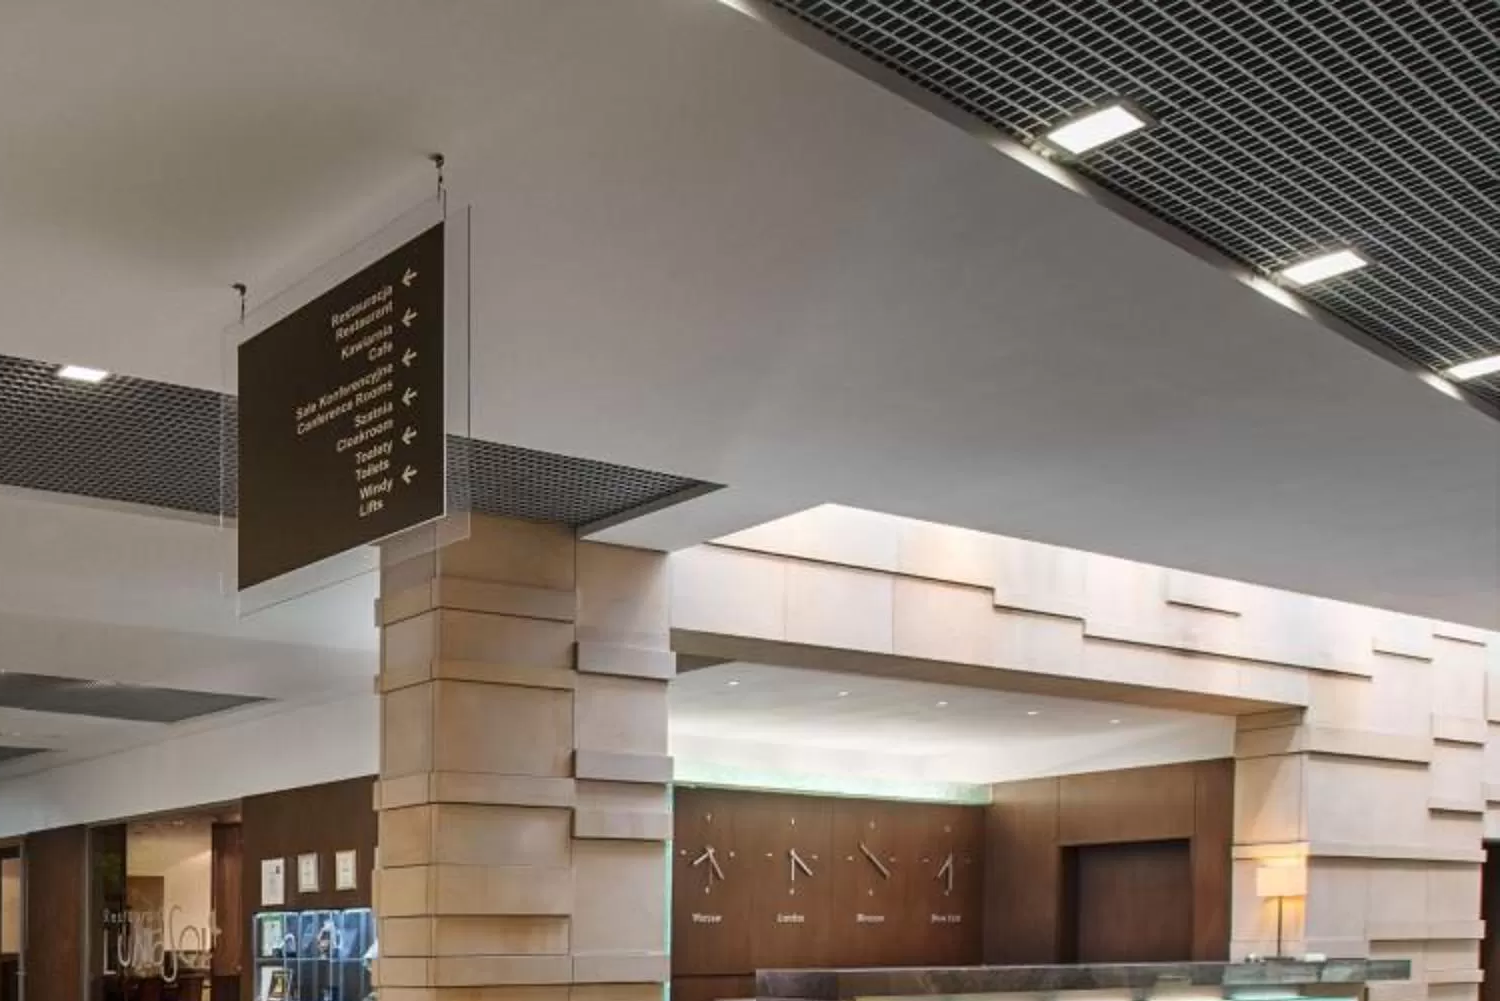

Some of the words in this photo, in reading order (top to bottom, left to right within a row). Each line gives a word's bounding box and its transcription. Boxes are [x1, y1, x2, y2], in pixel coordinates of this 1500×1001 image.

[331, 285, 393, 328] Restauracja
[335, 301, 393, 341] Restaurant
[341, 325, 393, 360] Kawiarnia
[297, 400, 353, 434] Conference
[355, 380, 393, 406] Rooms
[354, 401, 393, 427] Szatnia
[336, 419, 394, 452] Cloakroom
[355, 440, 393, 464] Toalety
[355, 459, 390, 482] Toilets
[359, 477, 393, 499] Windy
[359, 499, 383, 517] Lifts
